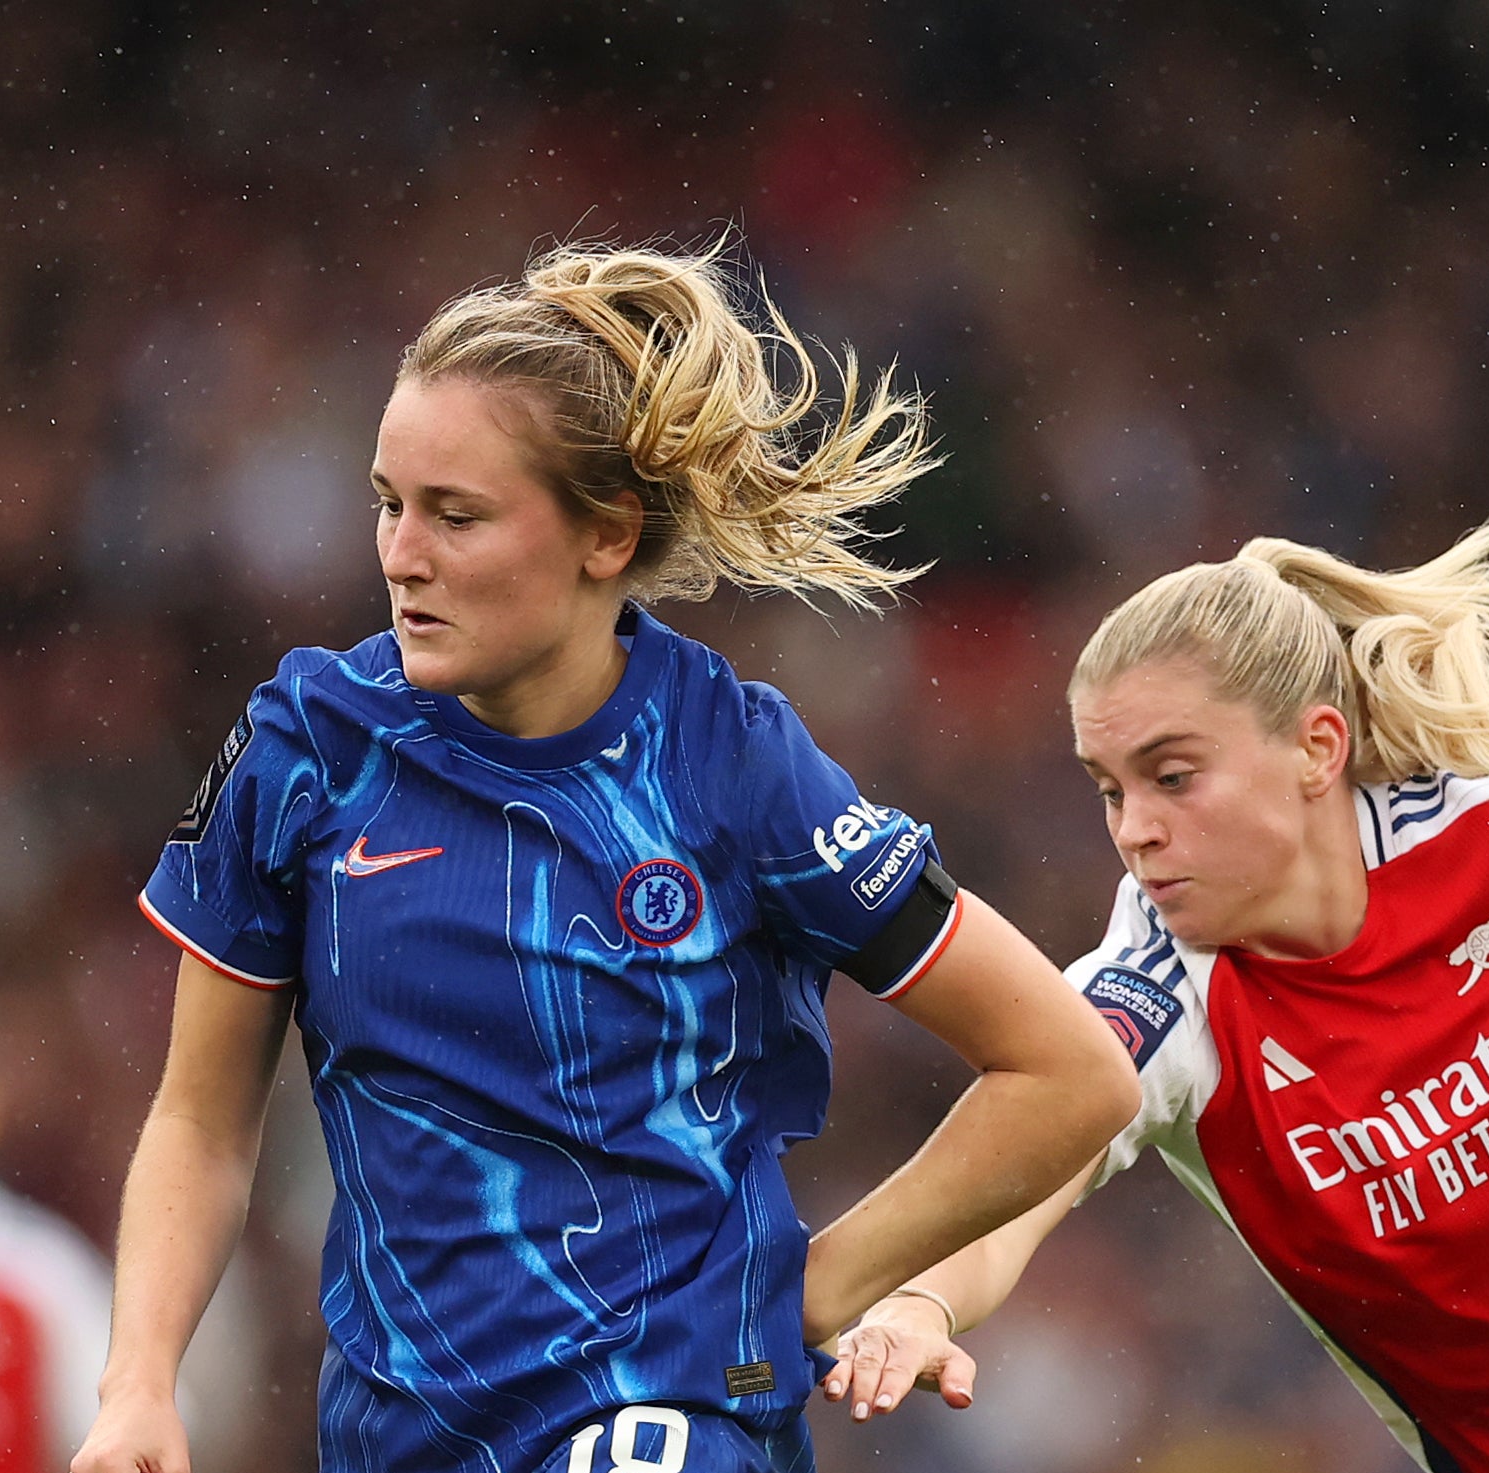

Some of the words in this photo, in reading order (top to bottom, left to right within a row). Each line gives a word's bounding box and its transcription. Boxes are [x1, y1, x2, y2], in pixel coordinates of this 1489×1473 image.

[635, 864, 686, 883] CHELSEA
[1090, 988, 1125, 1004] SUPER
[1125, 1001, 1163, 1031] LEAGUE
[1096, 980, 1168, 1023] WOMEN'S
[1117, 976, 1177, 1012] BARCLAYS
[1363, 1167, 1426, 1238] FLY
